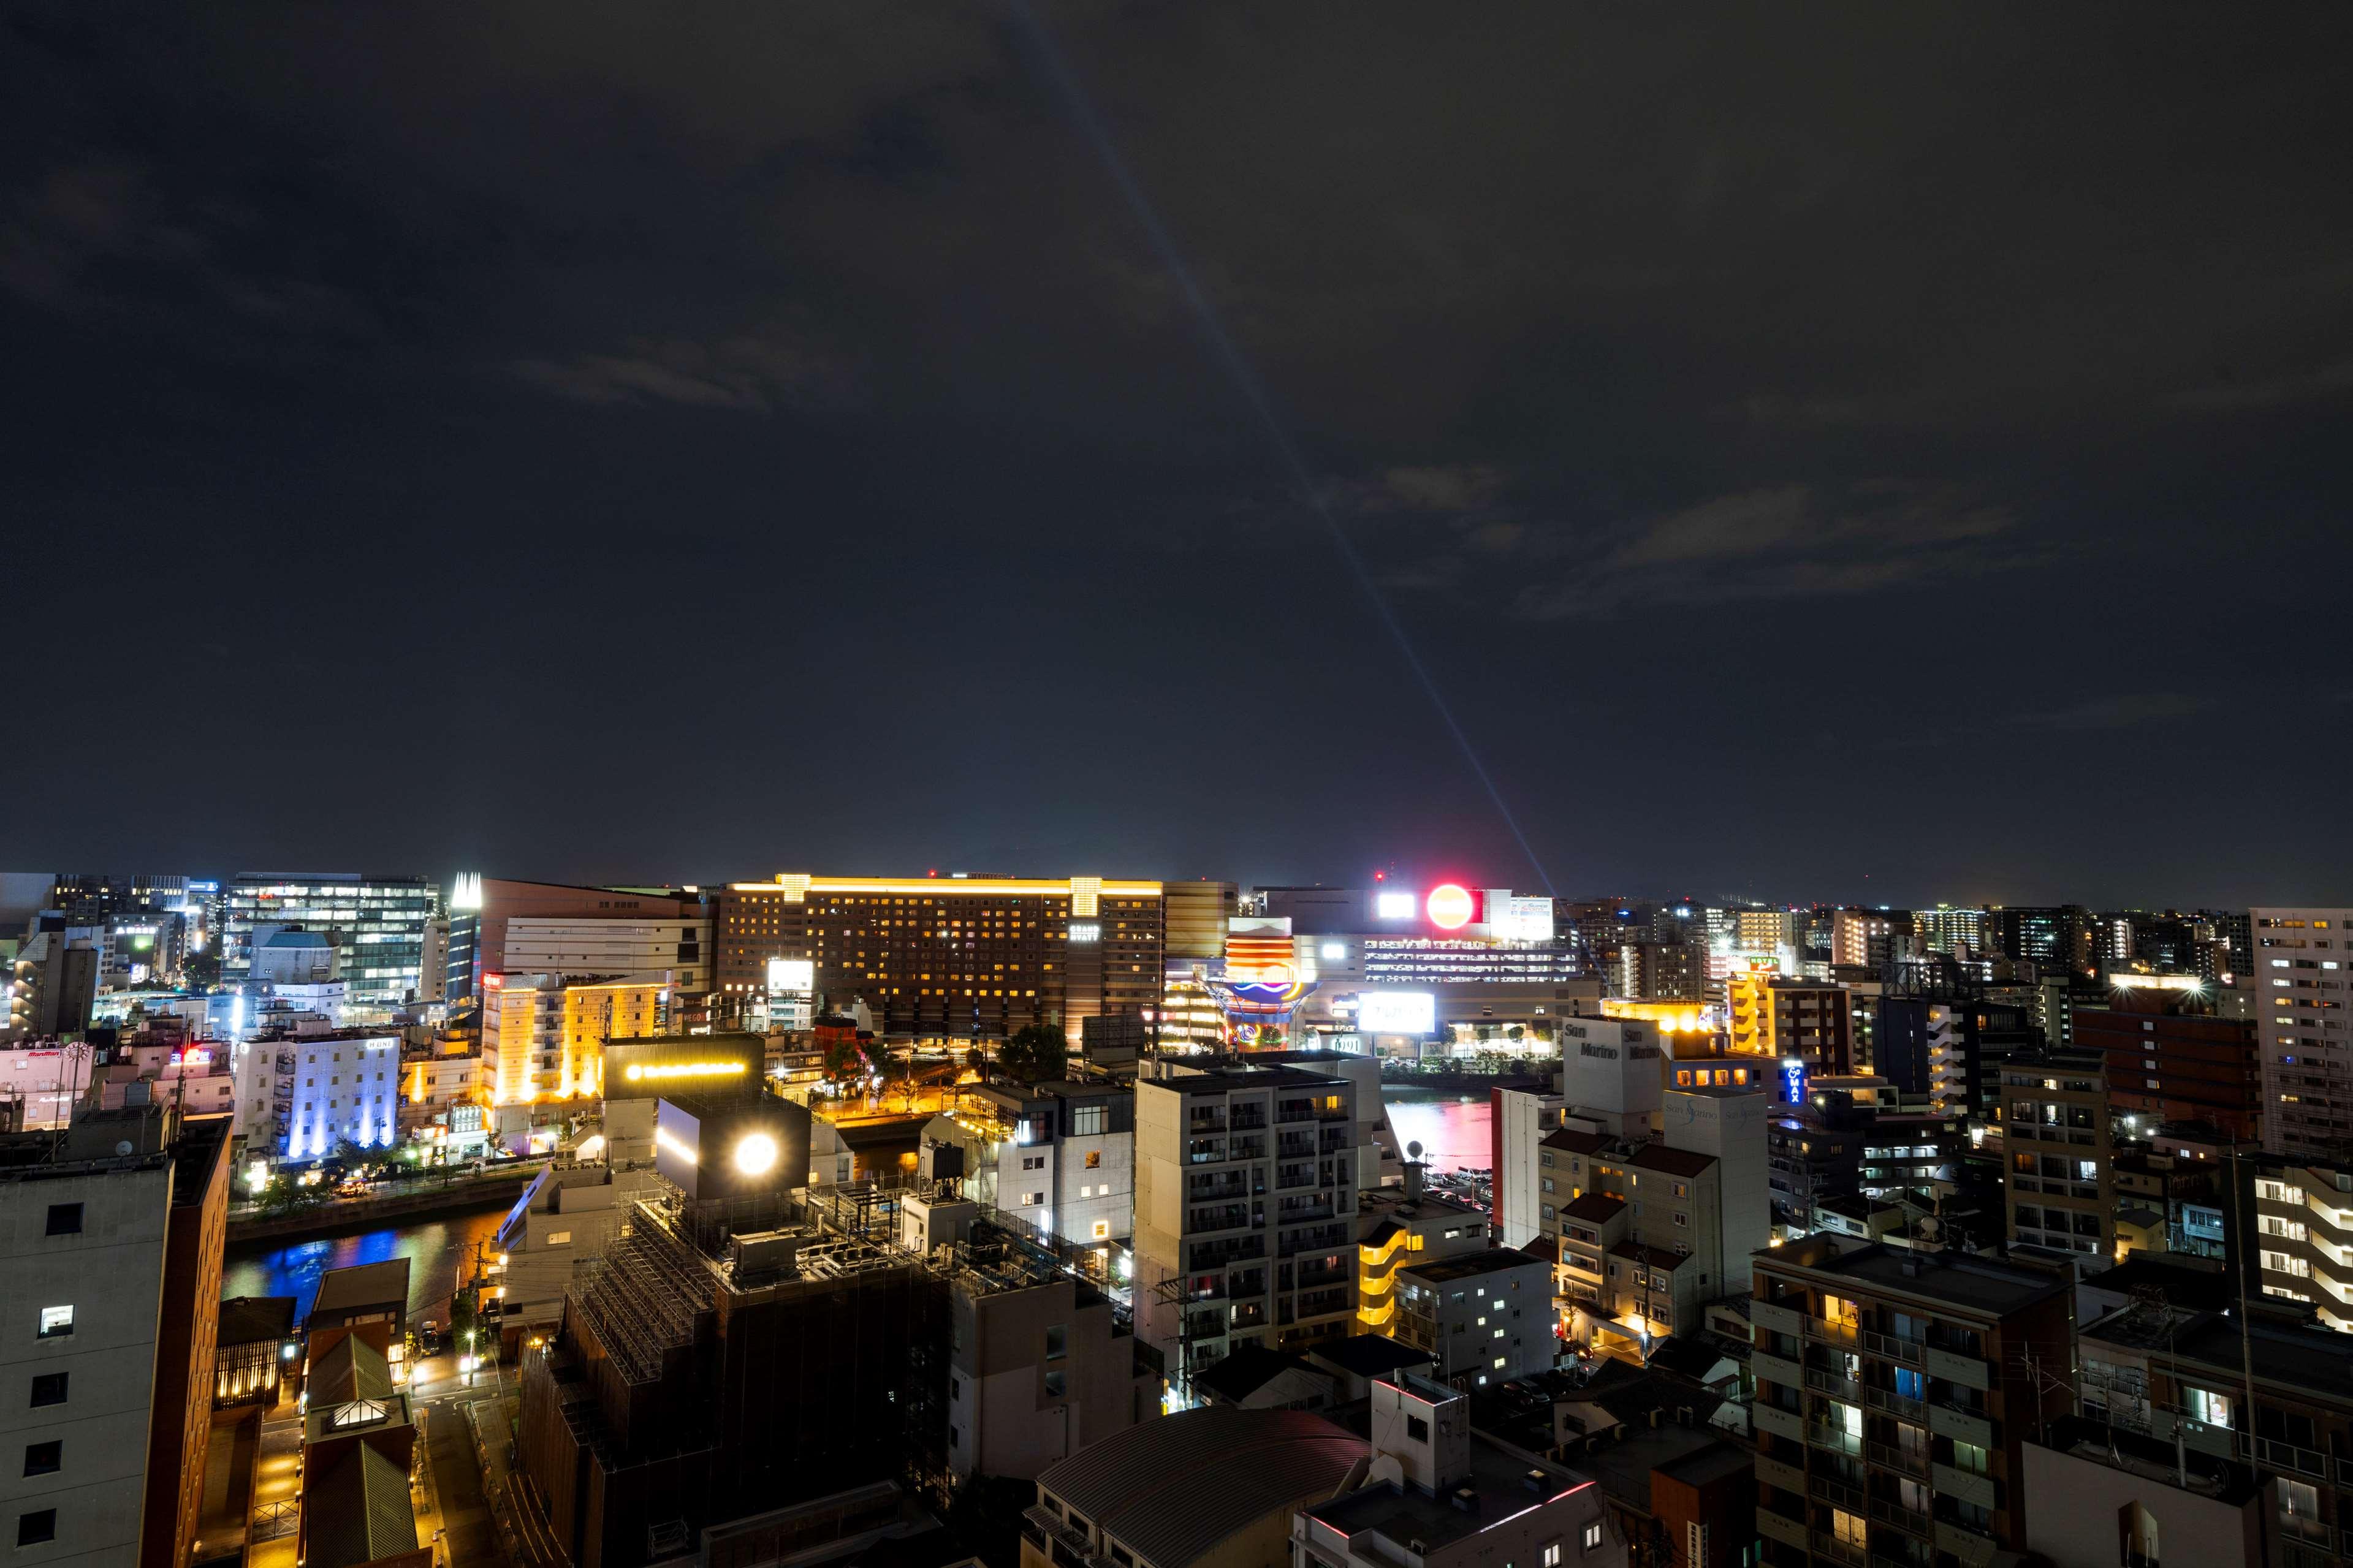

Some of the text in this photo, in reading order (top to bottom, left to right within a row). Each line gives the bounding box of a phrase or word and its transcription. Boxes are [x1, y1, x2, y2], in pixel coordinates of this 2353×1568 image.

[1565, 1024, 1587, 1038] San
[1625, 1029, 1642, 1042] San
[1581, 1043, 1617, 1059] Marino
[1629, 1045, 1660, 1060] Marino
[1788, 1067, 1801, 1078] &
[1790, 1078, 1800, 1102] MAX
[1666, 1104, 1717, 1119] San Marino
